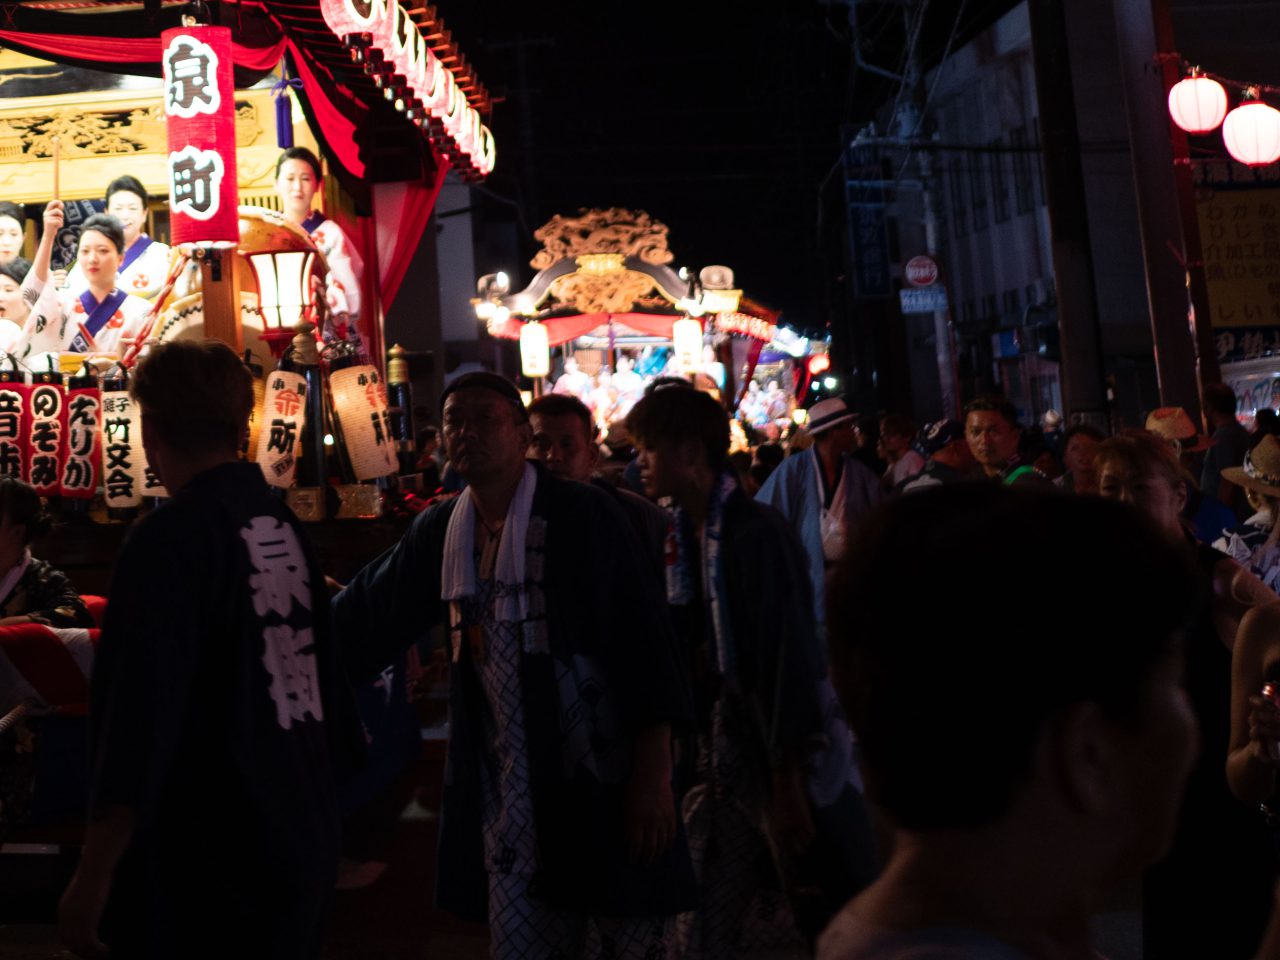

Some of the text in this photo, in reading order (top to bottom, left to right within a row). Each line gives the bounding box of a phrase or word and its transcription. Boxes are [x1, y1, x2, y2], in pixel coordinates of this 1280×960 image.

[165, 38, 222, 218] 泉町
[31, 385, 61, 487] のぞみ
[63, 395, 98, 488] えりか
[104, 416, 135, 499] 竹文会
